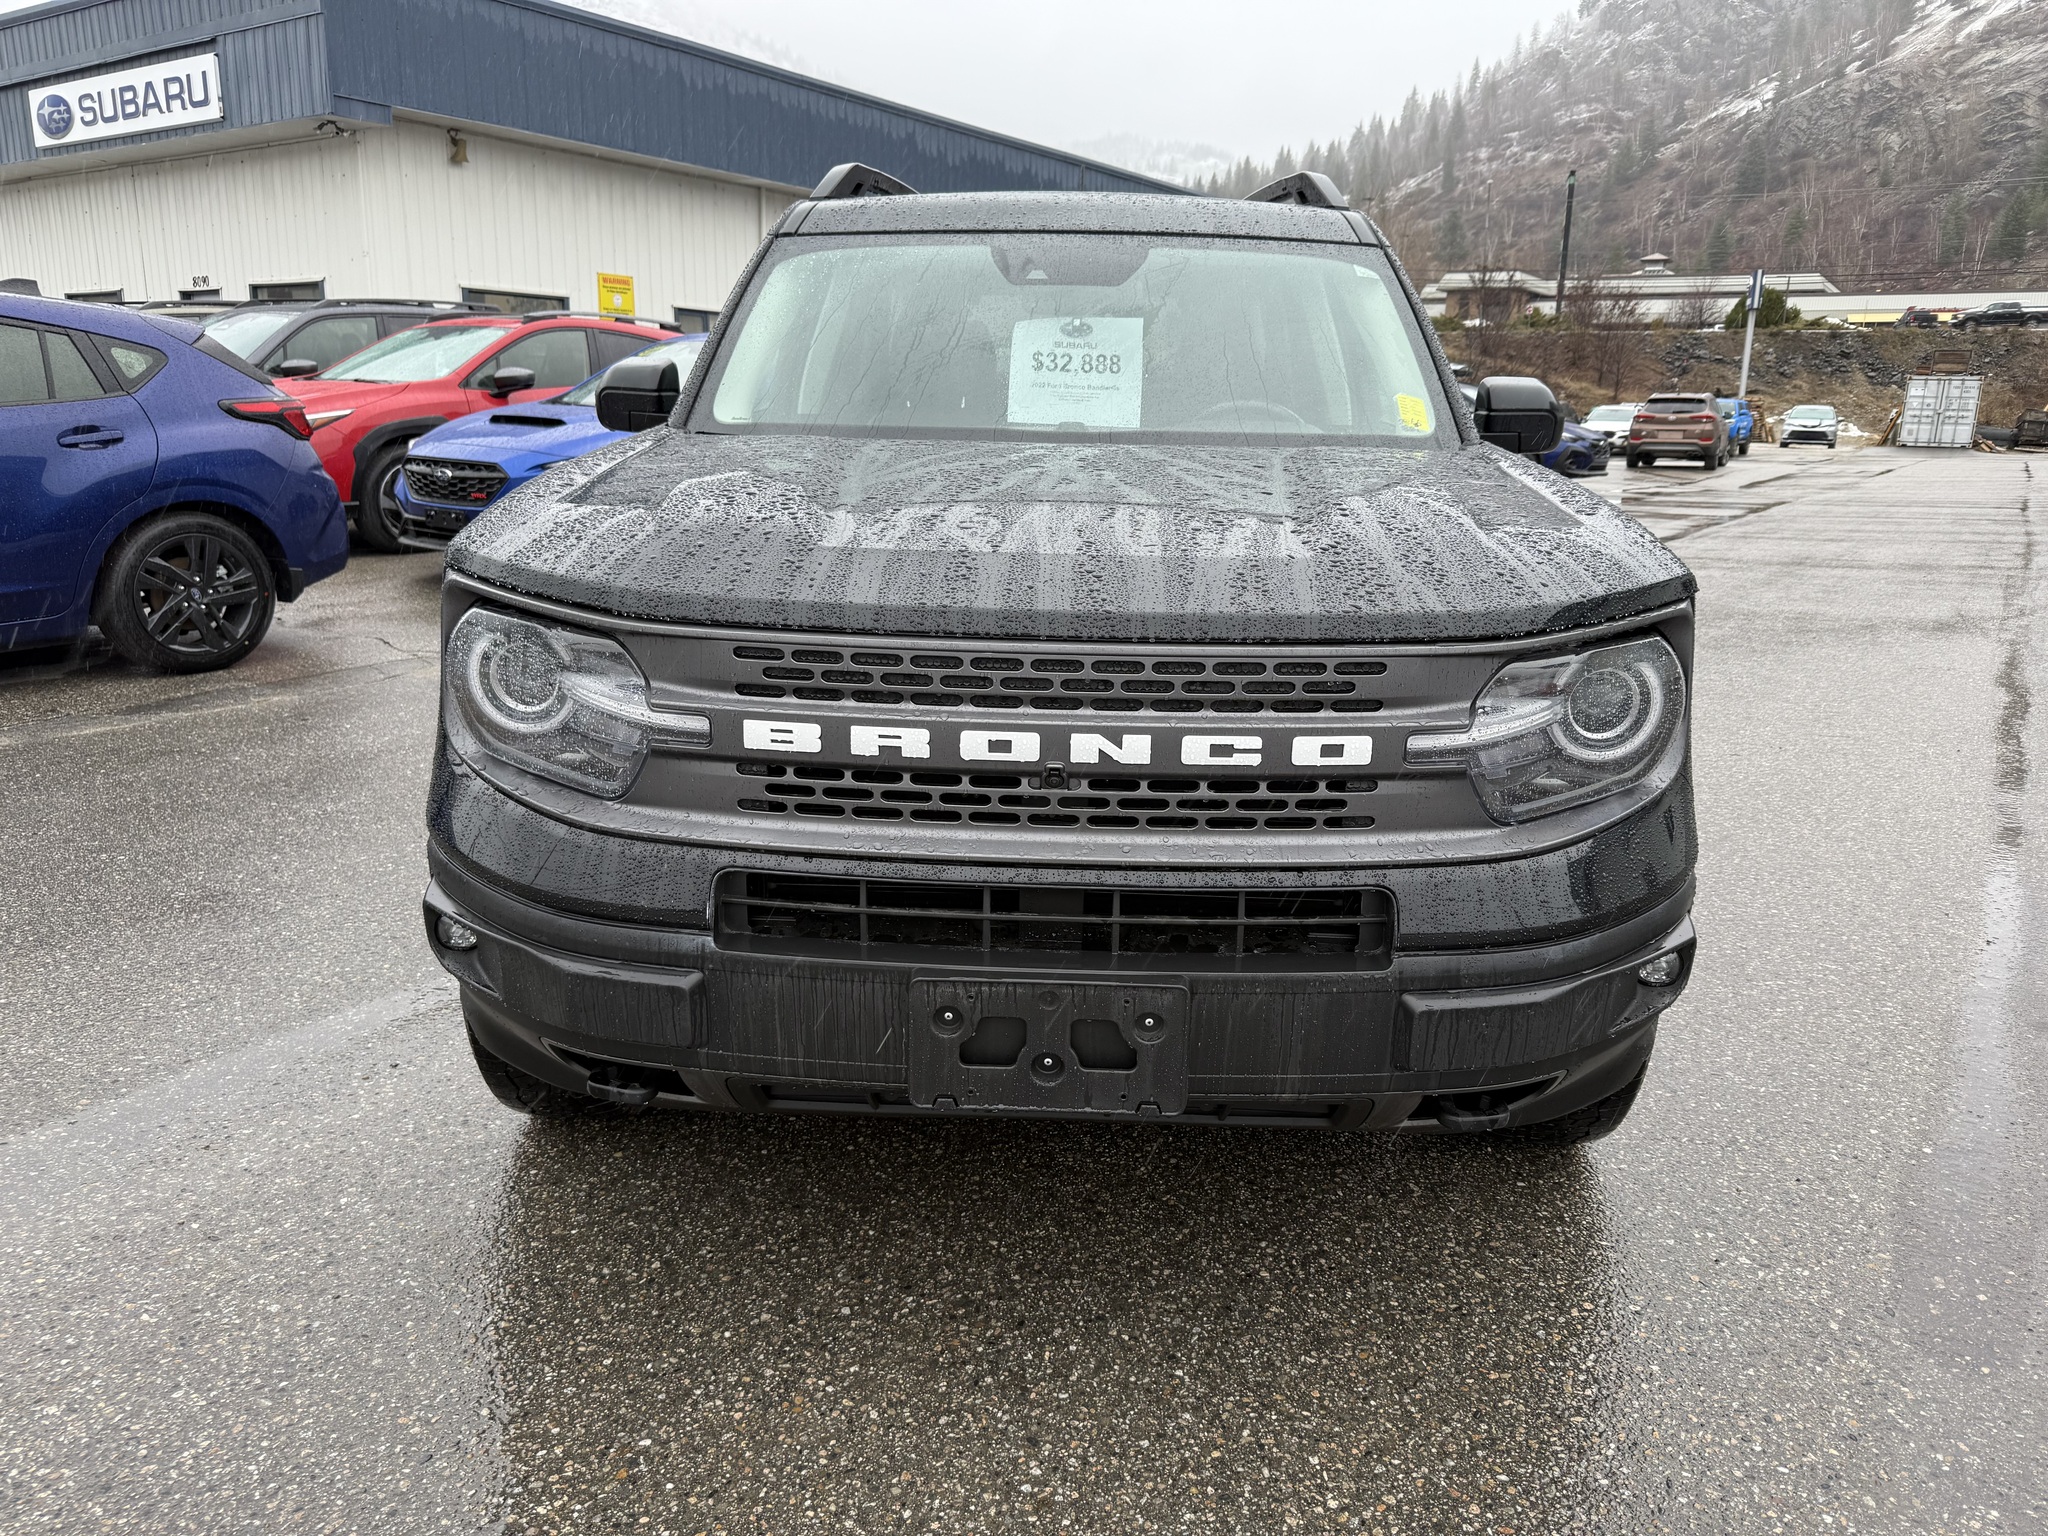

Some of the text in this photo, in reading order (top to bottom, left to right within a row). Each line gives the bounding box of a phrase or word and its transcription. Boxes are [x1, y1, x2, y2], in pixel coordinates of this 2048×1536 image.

[78, 71, 211, 127] SUBARU
[192, 275, 210, 288] 8090
[1054, 341, 1098, 350] SUBARU
[1031, 350, 1121, 376] $32,888
[743, 719, 1373, 766] BRONCO
